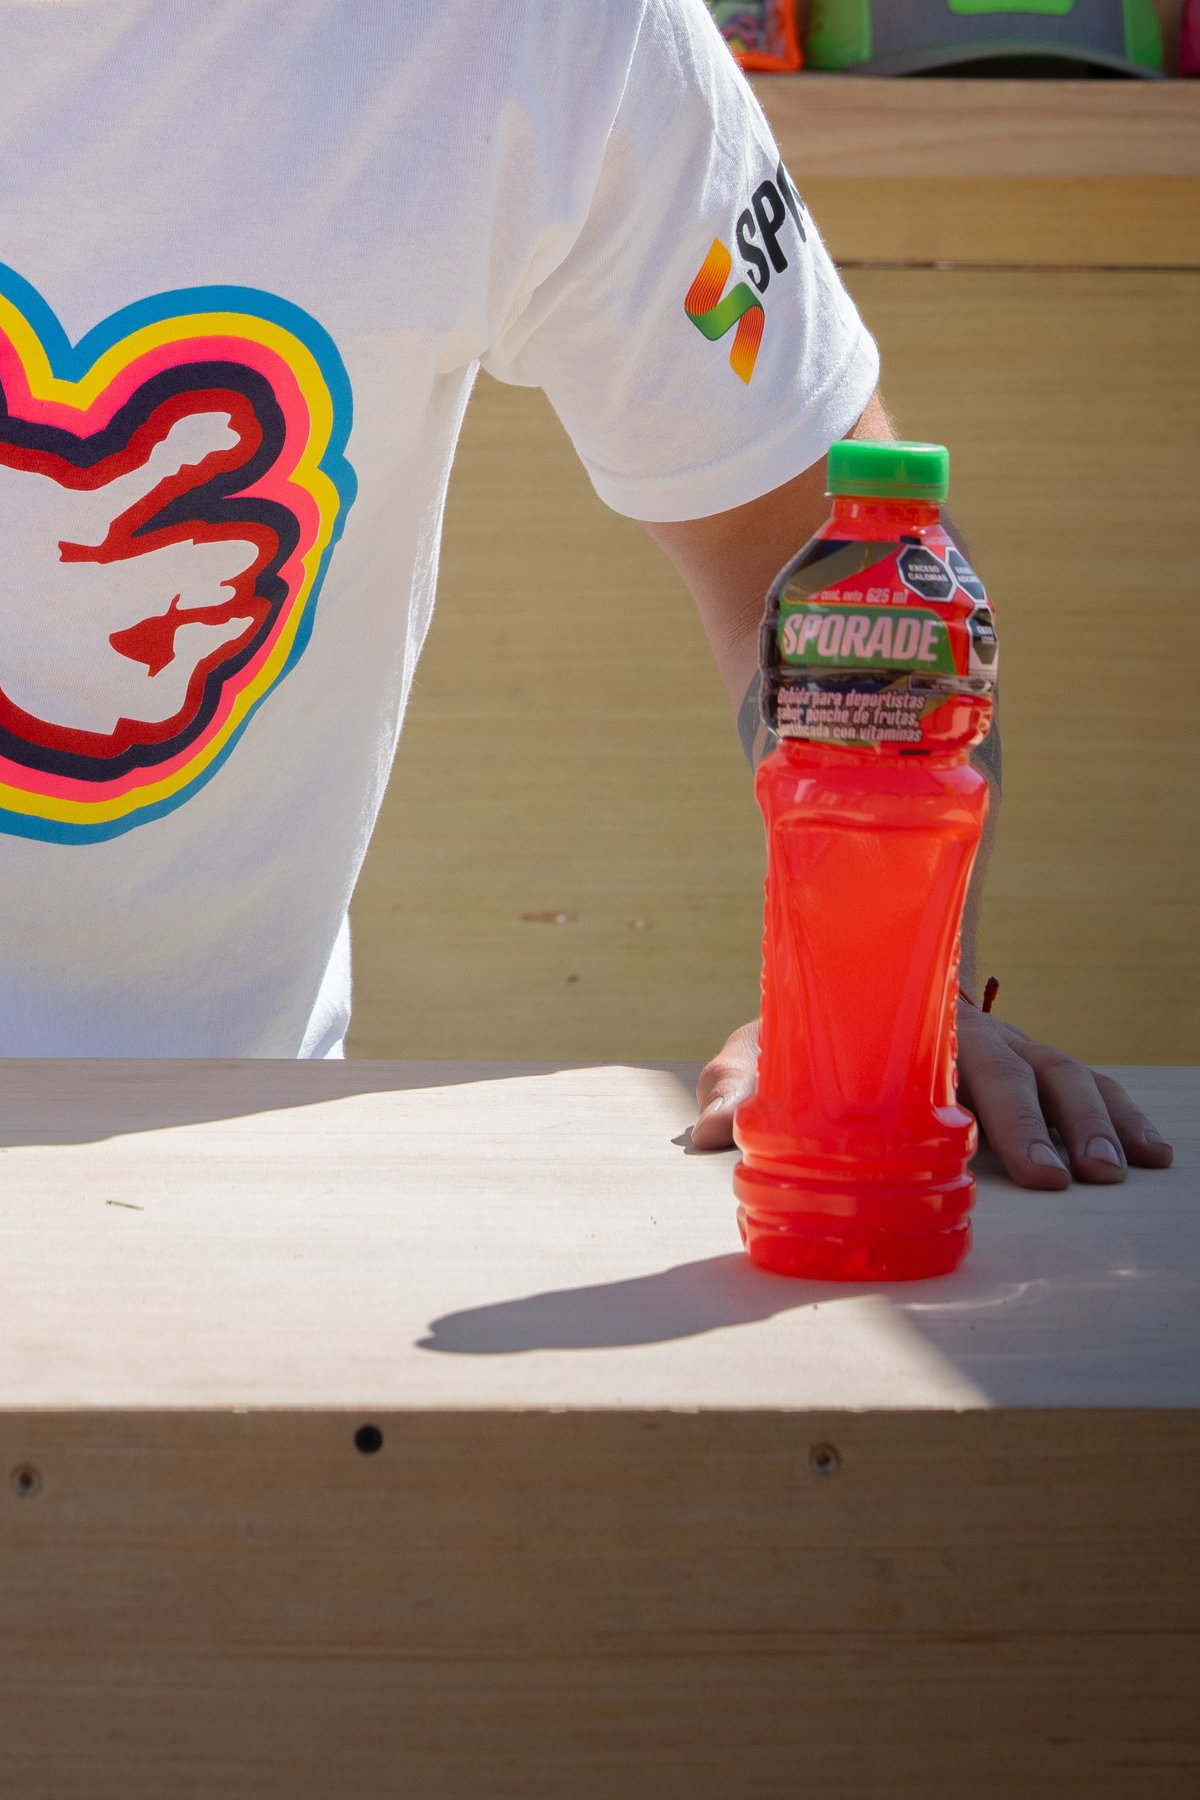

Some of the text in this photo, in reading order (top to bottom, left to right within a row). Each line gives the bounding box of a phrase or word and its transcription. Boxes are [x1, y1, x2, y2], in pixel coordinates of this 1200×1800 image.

[866, 587, 890, 604] 625
[892, 588, 908, 604] ml
[784, 613, 938, 661] SPORADE
[812, 691, 842, 709] para
[845, 689, 925, 712] deportistas
[806, 705, 849, 727] ponche
[853, 707, 870, 725] de
[833, 726, 856, 739] con
[860, 724, 923, 742] vitaminas
